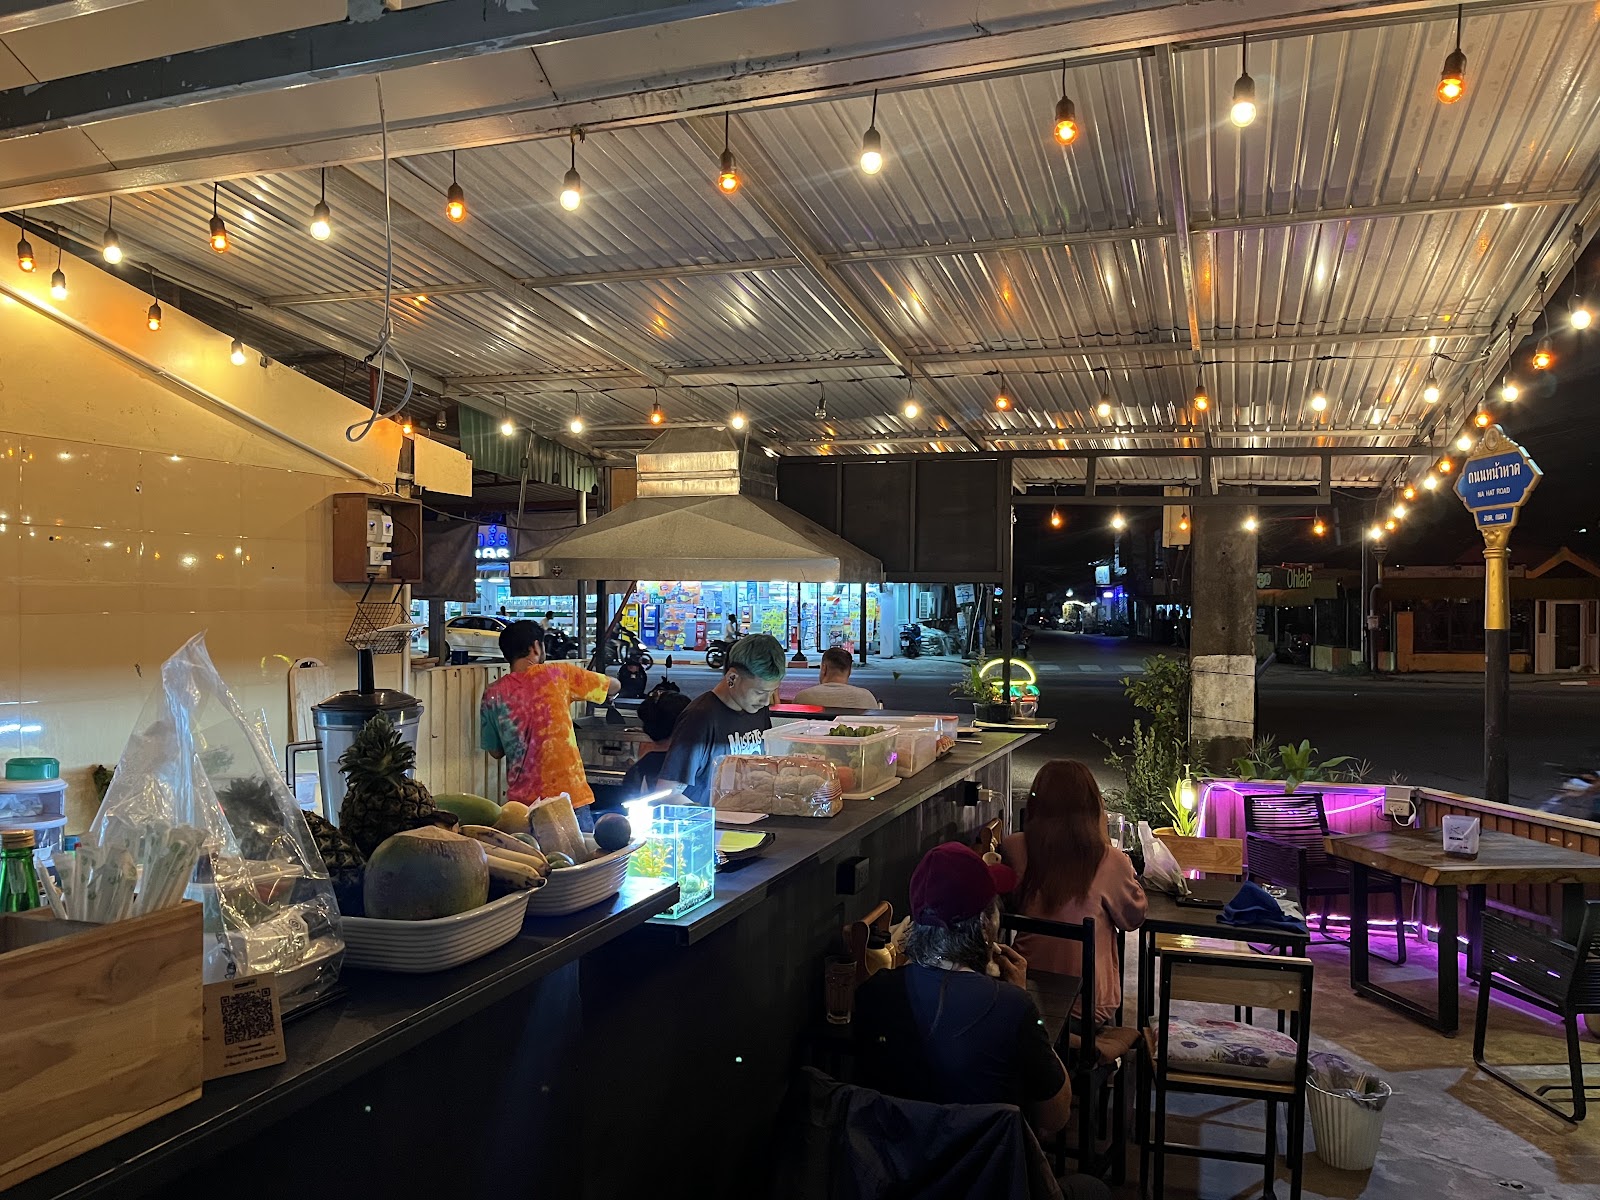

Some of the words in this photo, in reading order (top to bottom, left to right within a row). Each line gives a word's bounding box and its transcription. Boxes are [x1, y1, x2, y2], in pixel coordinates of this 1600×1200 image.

[1468, 462, 1521, 484] ถนนหน้าหาด
[1486, 488, 1496, 496] HAT
[1497, 486, 1511, 495] ROAD
